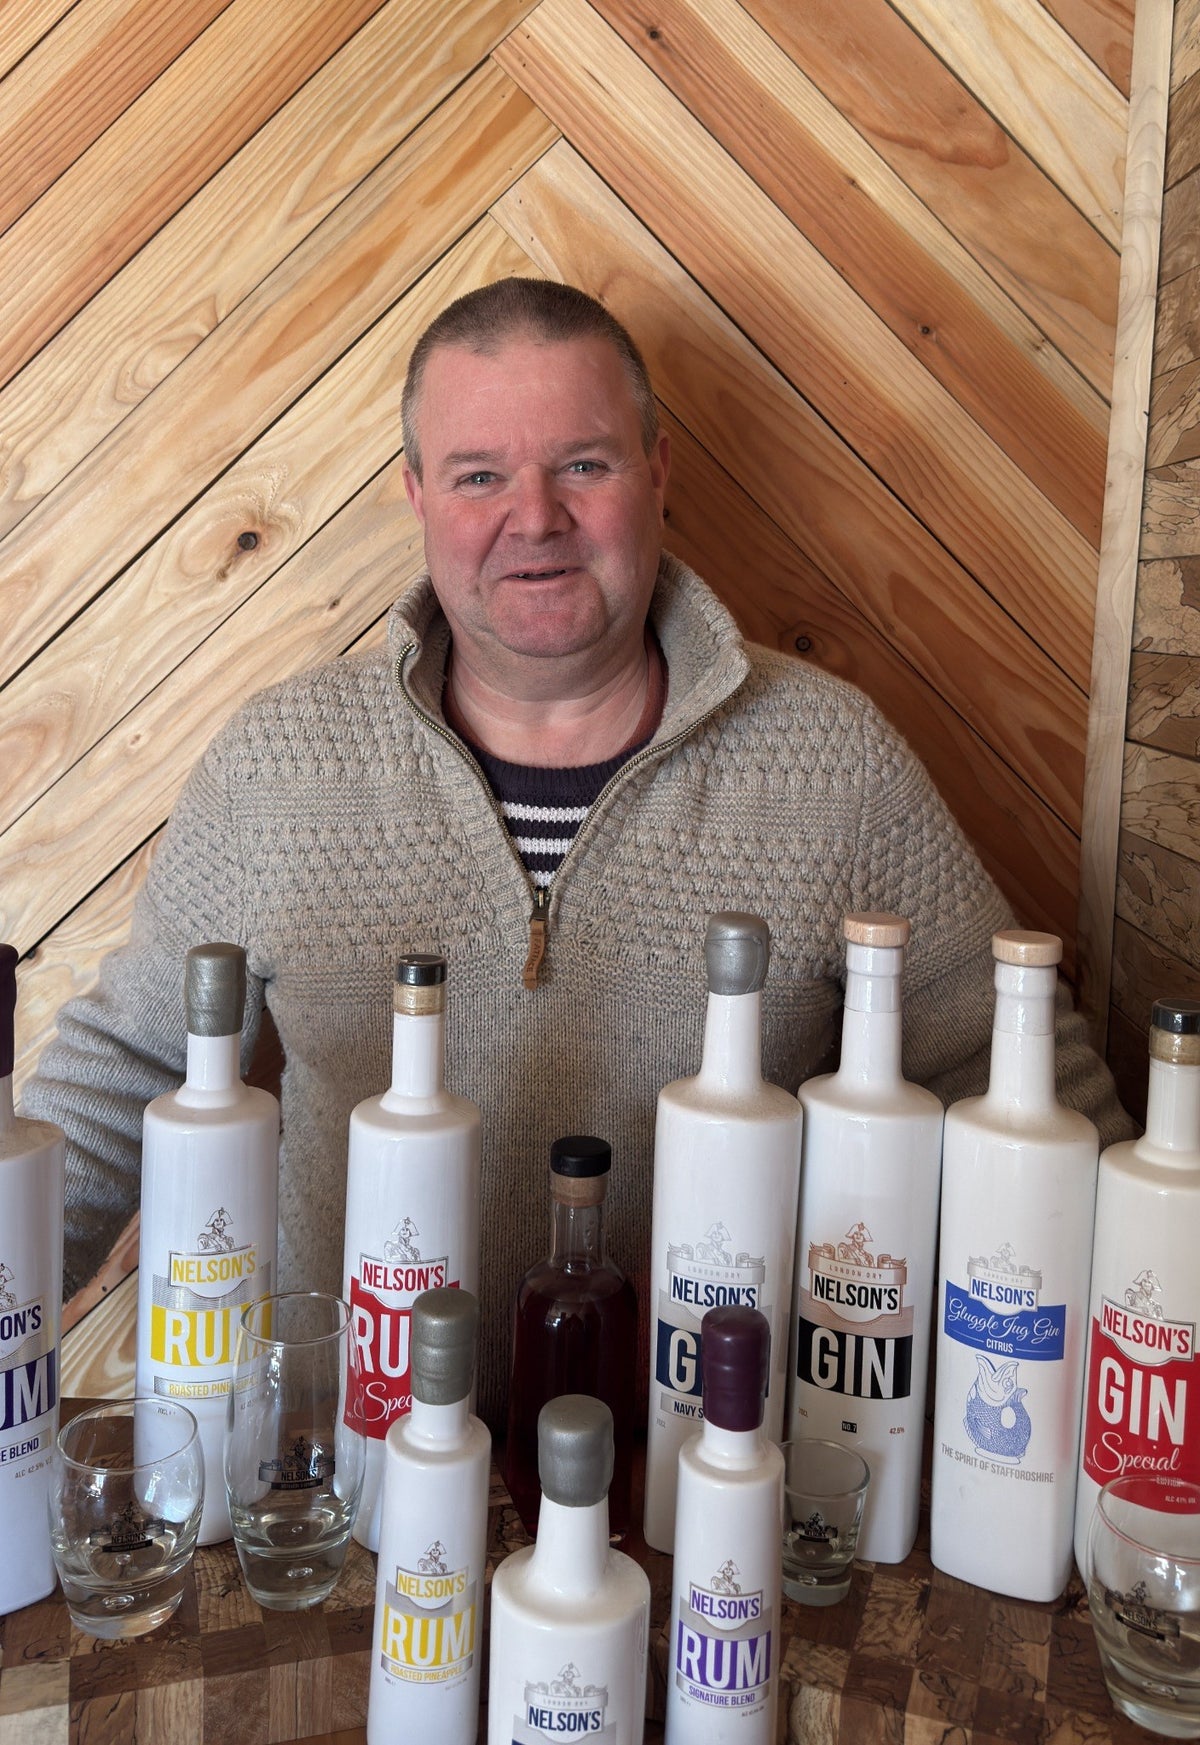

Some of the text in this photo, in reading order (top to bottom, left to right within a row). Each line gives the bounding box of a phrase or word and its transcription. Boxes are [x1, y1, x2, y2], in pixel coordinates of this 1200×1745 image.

[173, 1251, 257, 1283] NELSON'S
[363, 1261, 444, 1292] NELSON'S
[829, 1264, 861, 1277] LONDON
[672, 1275, 757, 1309] NELSON'S
[814, 1274, 898, 1311] NELSON'S
[971, 1278, 1035, 1307] NELSON'S
[0, 1305, 42, 1341] ON'S
[164, 1301, 263, 1366] RUM
[947, 1296, 1060, 1345] Gluggle Jug Gin
[1102, 1304, 1190, 1354] NELSON'S
[350, 1303, 410, 1378] RU
[986, 1338, 1014, 1354] CITRUS
[811, 1327, 895, 1400] GIN
[169, 1384, 209, 1397] ROASTED
[353, 1381, 412, 1422] Spec
[1098, 1355, 1187, 1446] GIN
[673, 1401, 697, 1417] NAVY
[9, 1437, 40, 1464] BLEND
[941, 1443, 1055, 1483] THE SPIRIT OF STAFFORDSHIRE
[1092, 1431, 1181, 1476] Special
[281, 1468, 317, 1481] NELSONS
[397, 1573, 465, 1598] NELSON'S
[691, 1589, 760, 1620] NELSON'S
[386, 1606, 471, 1666] RUM
[390, 1664, 463, 1681] ROASTED PINEAPPLE
[680, 1627, 766, 1690] RUM
[688, 1685, 730, 1706] SIGNATURE
[731, 1692, 756, 1706] BLEND
[528, 1705, 601, 1732] NELSON'S
